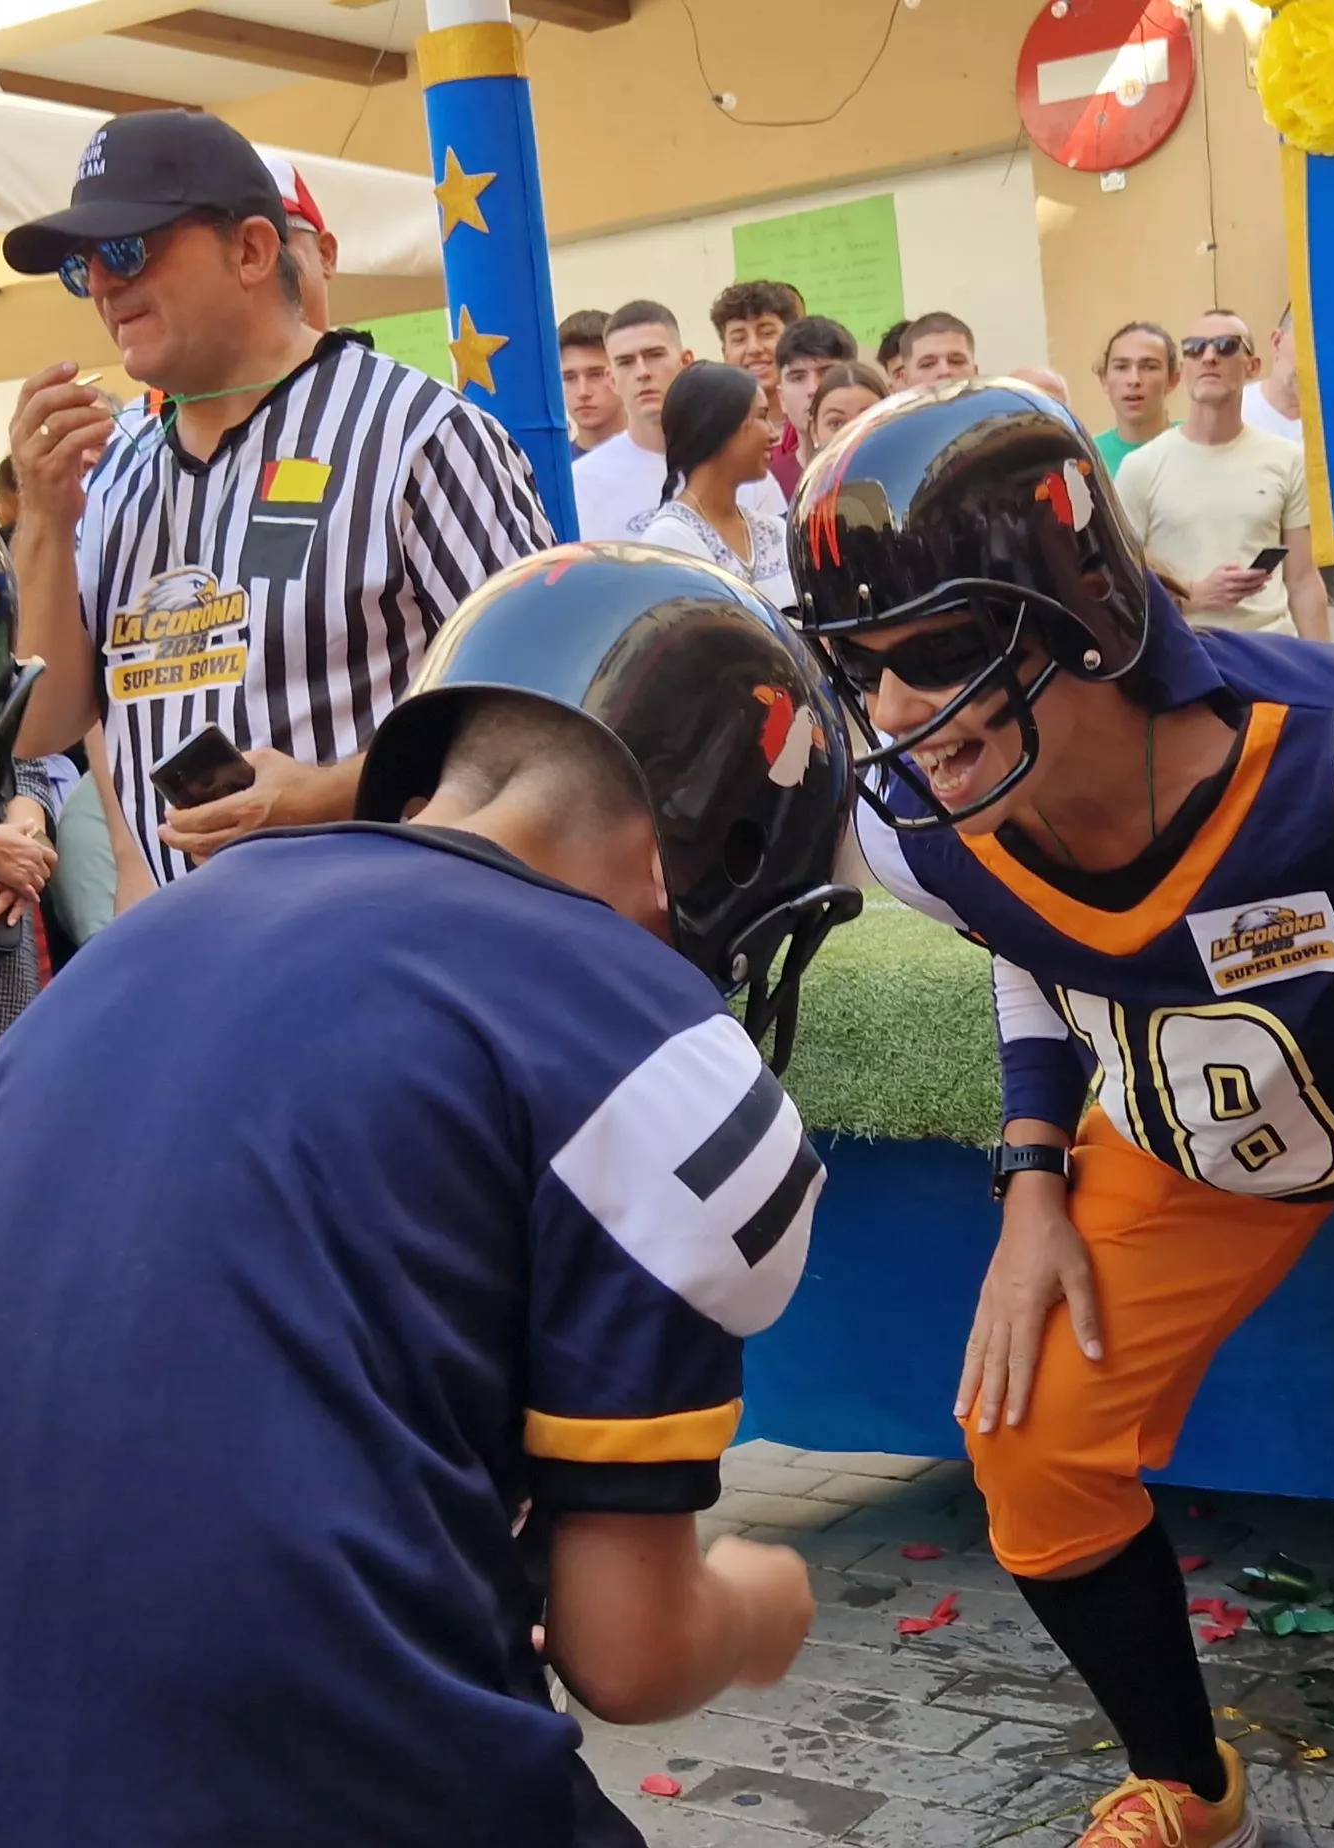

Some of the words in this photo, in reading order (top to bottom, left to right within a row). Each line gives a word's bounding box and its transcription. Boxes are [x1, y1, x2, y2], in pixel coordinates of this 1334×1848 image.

[113, 614, 142, 648] LA
[145, 592, 244, 641] CORONA
[123, 665, 183, 691] SUPER
[189, 653, 240, 680] BOWL
[1211, 937, 1238, 962] LA
[1240, 912, 1325, 950] CORONA
[1224, 957, 1276, 984] SUPER
[1281, 943, 1329, 965] BOWL
